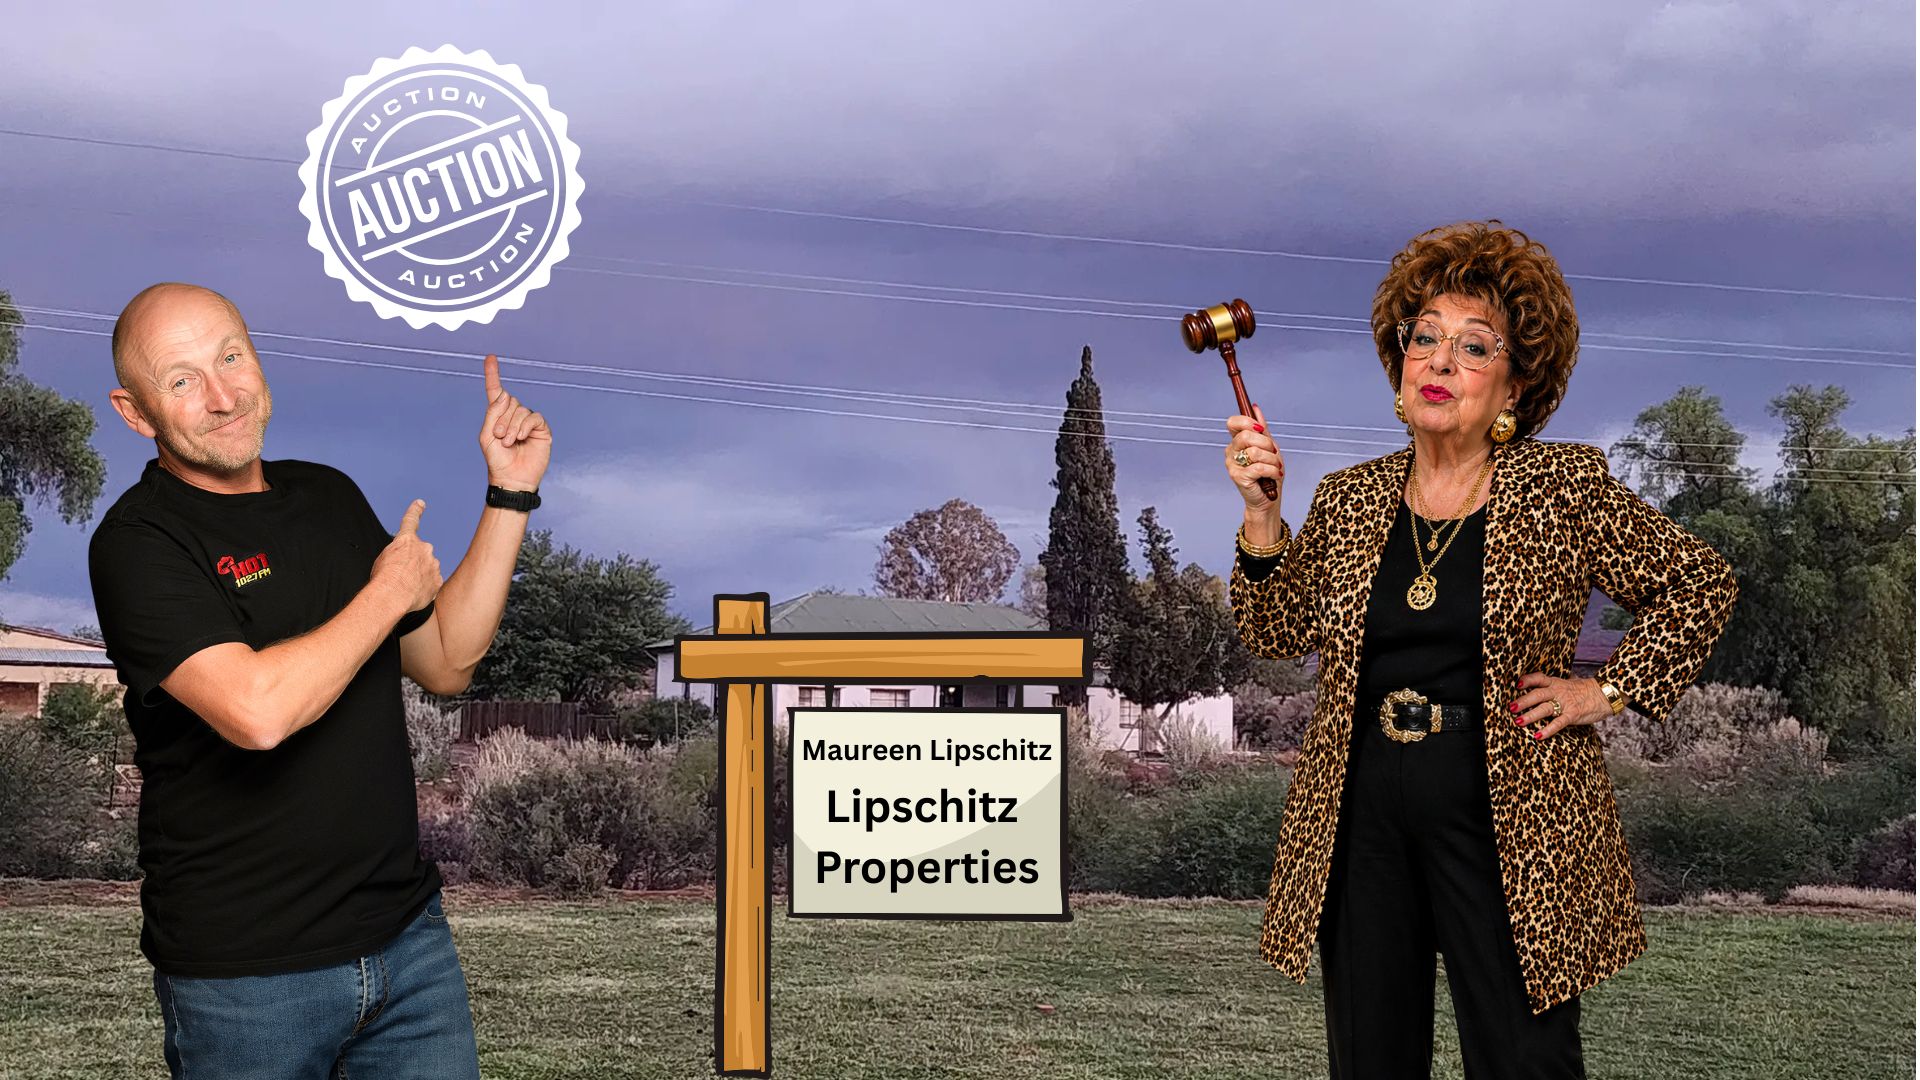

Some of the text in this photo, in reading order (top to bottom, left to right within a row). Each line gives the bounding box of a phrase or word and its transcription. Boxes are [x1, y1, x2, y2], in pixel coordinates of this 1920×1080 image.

[231, 553, 268, 579] HOT
[803, 738, 1053, 766] Maureen Lipschitz
[828, 788, 1018, 832] Lipschitz
[817, 849, 1039, 893] Properties
